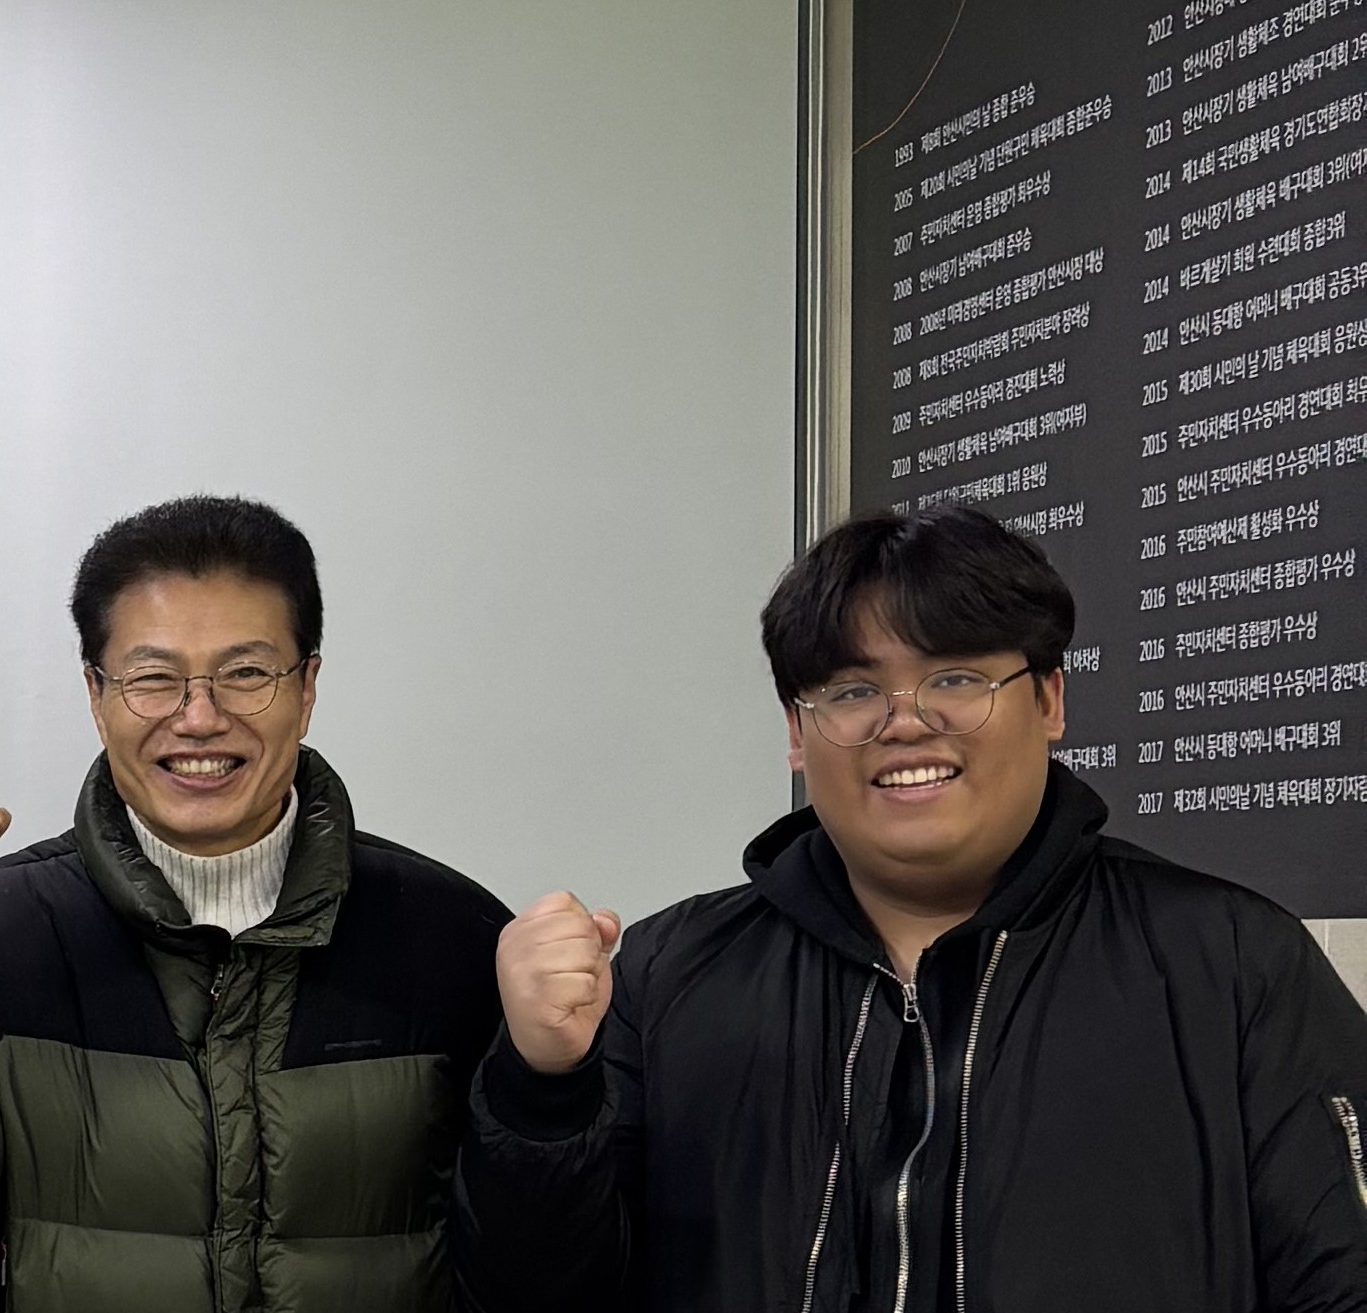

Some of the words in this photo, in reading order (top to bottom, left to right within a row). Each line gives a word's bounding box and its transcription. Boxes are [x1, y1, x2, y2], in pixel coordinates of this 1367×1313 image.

[1148, 15, 1172, 45] 2012
[1147, 67, 1171, 97] 2013
[1183, 36, 1234, 82] 안산시장기
[1146, 120, 1171, 148] 2013
[1183, 90, 1233, 135] 안산시장기
[1146, 171, 1170, 198] 2014
[1182, 151, 1215, 183] 제14회
[1145, 224, 1170, 251] 2014
[1181, 198, 1231, 240] 안산시장기
[1279, 164, 1324, 200] 배구대회
[1144, 276, 1169, 303] 2014
[1180, 252, 1230, 290] 바르게살기
[1233, 243, 1254, 271] 회원
[1257, 226, 1300, 265] 수련대회
[1143, 328, 1168, 354] 2014
[1179, 312, 1209, 345] 안산시
[1246, 290, 1278, 321] 어머니
[1280, 274, 1325, 310] 배구대회
[1143, 380, 1168, 406] 2015
[1179, 364, 1211, 395] 제30회
[1214, 354, 1245, 385] 시민의
[1262, 344, 1283, 371] 기념
[1286, 328, 1331, 364] 체육대회
[1142, 432, 1167, 457] 2015
[1178, 410, 1239, 449] 주민자치센터
[1298, 382, 1343, 419] 경연대회
[1141, 483, 1166, 508] 2015
[1178, 471, 1207, 502] 안산시
[1210, 455, 1273, 493] 주민자치센터
[1049, 501, 1084, 530] 최우수상
[1141, 535, 1166, 559] 2016
[1177, 515, 1247, 554] 주민참여예산제
[1250, 508, 1283, 540] 활성화
[1285, 500, 1319, 531] 우수상
[1140, 587, 1165, 610] 2016
[1176, 576, 1206, 606] 안산시
[1208, 564, 1271, 600] 주민자치센터
[1273, 556, 1318, 589] 종합평가
[1320, 549, 1355, 580] 우수상
[1140, 638, 1164, 661] 2016
[1175, 624, 1236, 658] 주민자치센터
[1238, 618, 1281, 649] 종합평가
[1283, 611, 1317, 642] 우수상
[1139, 690, 1164, 712] 2016
[1175, 682, 1205, 710] 안산시
[1207, 674, 1269, 706] 주민자치센터
[1139, 741, 1163, 763] 2017
[1175, 735, 1204, 762] 안산시
[1240, 727, 1271, 754] 어머니
[1275, 722, 1318, 751] 배구대회
[1322, 720, 1340, 745] 3위
[1138, 792, 1163, 813] 2017
[1174, 787, 1206, 812] 제32회
[1209, 784, 1250, 811] 시민의날
[1253, 782, 1274, 808] 기념
[1277, 778, 1321, 806] 체육대회
